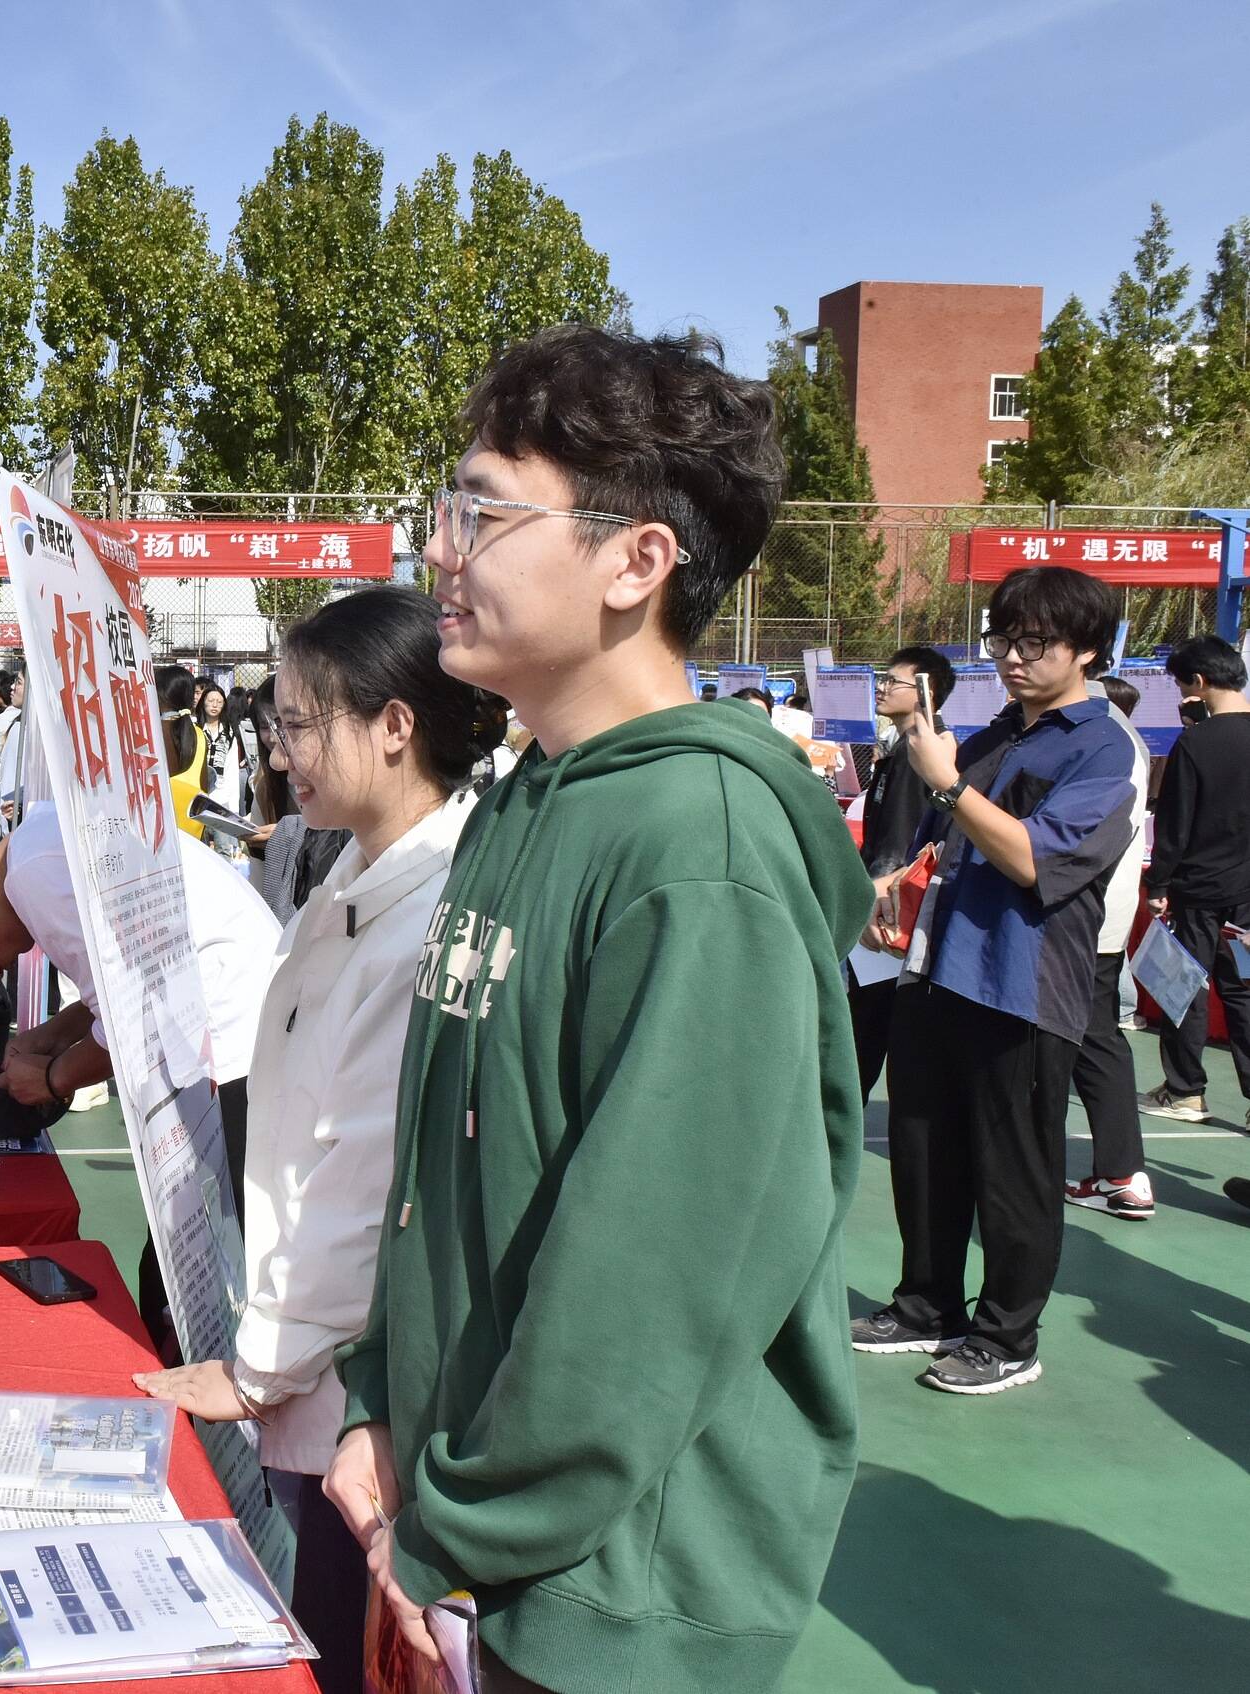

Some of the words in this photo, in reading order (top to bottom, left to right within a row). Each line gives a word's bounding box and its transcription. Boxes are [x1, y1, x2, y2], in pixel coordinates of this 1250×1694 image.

[35, 512, 76, 563] 东明石化
[143, 533, 210, 558] 扬帆
[319, 533, 350, 559] 海
[1000, 537, 1066, 561] “机”
[1081, 538, 1168, 562] 遇无限
[105, 602, 137, 671] 校园
